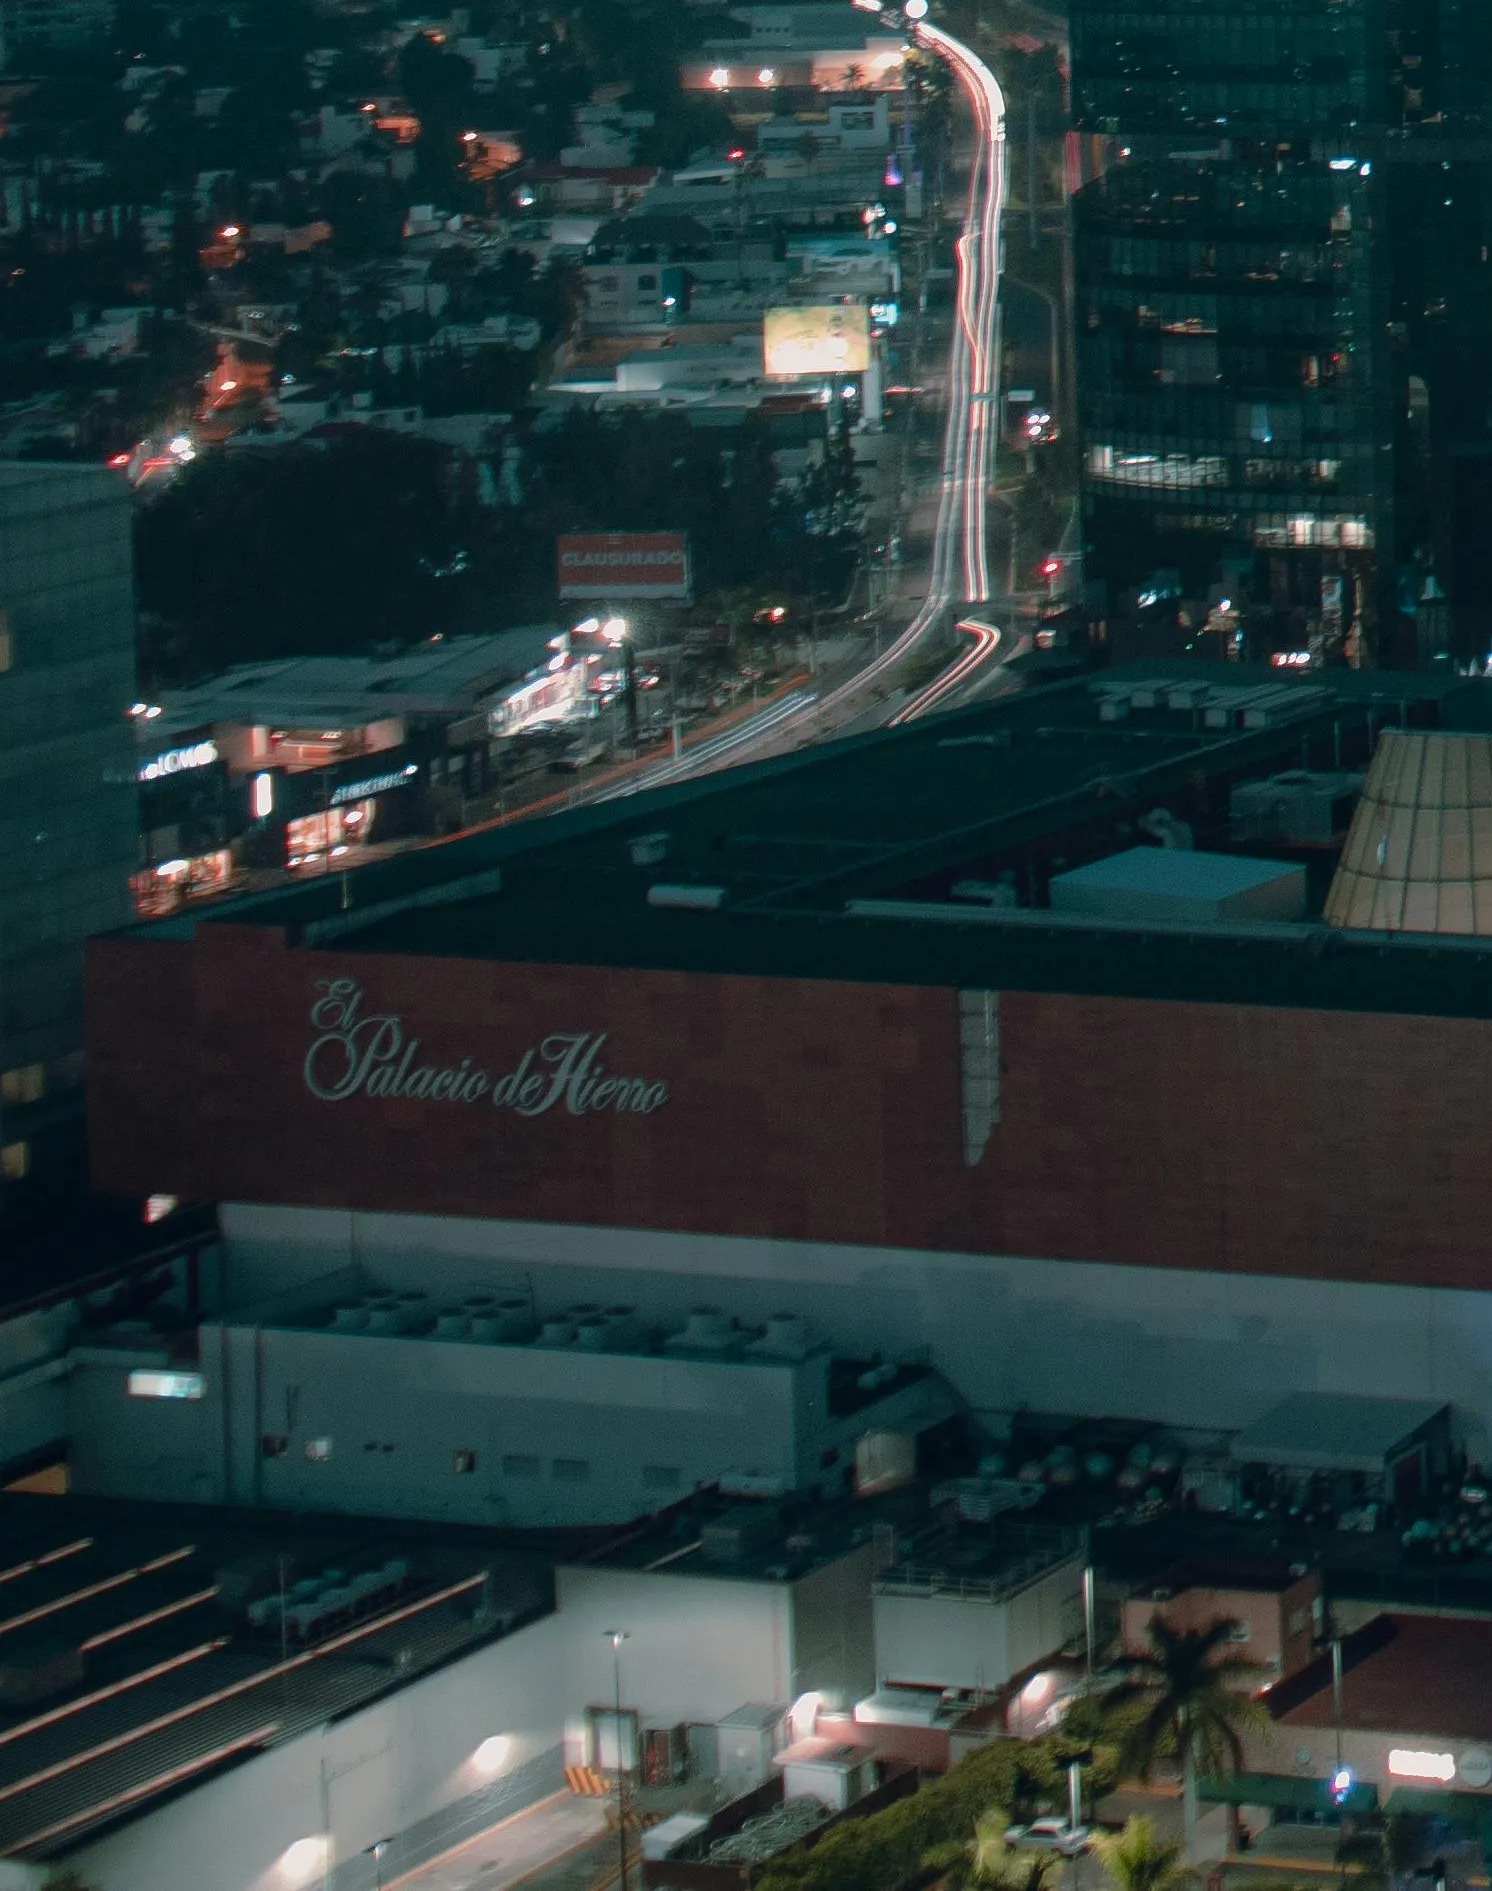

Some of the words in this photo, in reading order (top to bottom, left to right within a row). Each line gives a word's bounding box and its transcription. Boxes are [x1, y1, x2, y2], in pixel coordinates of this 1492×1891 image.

[561, 550, 682, 567] CLAUSURADO
[310, 978, 363, 1031] El
[303, 1014, 488, 1101] Palacio
[492, 1048, 542, 1108] de
[518, 1030, 670, 1117] Hierro
